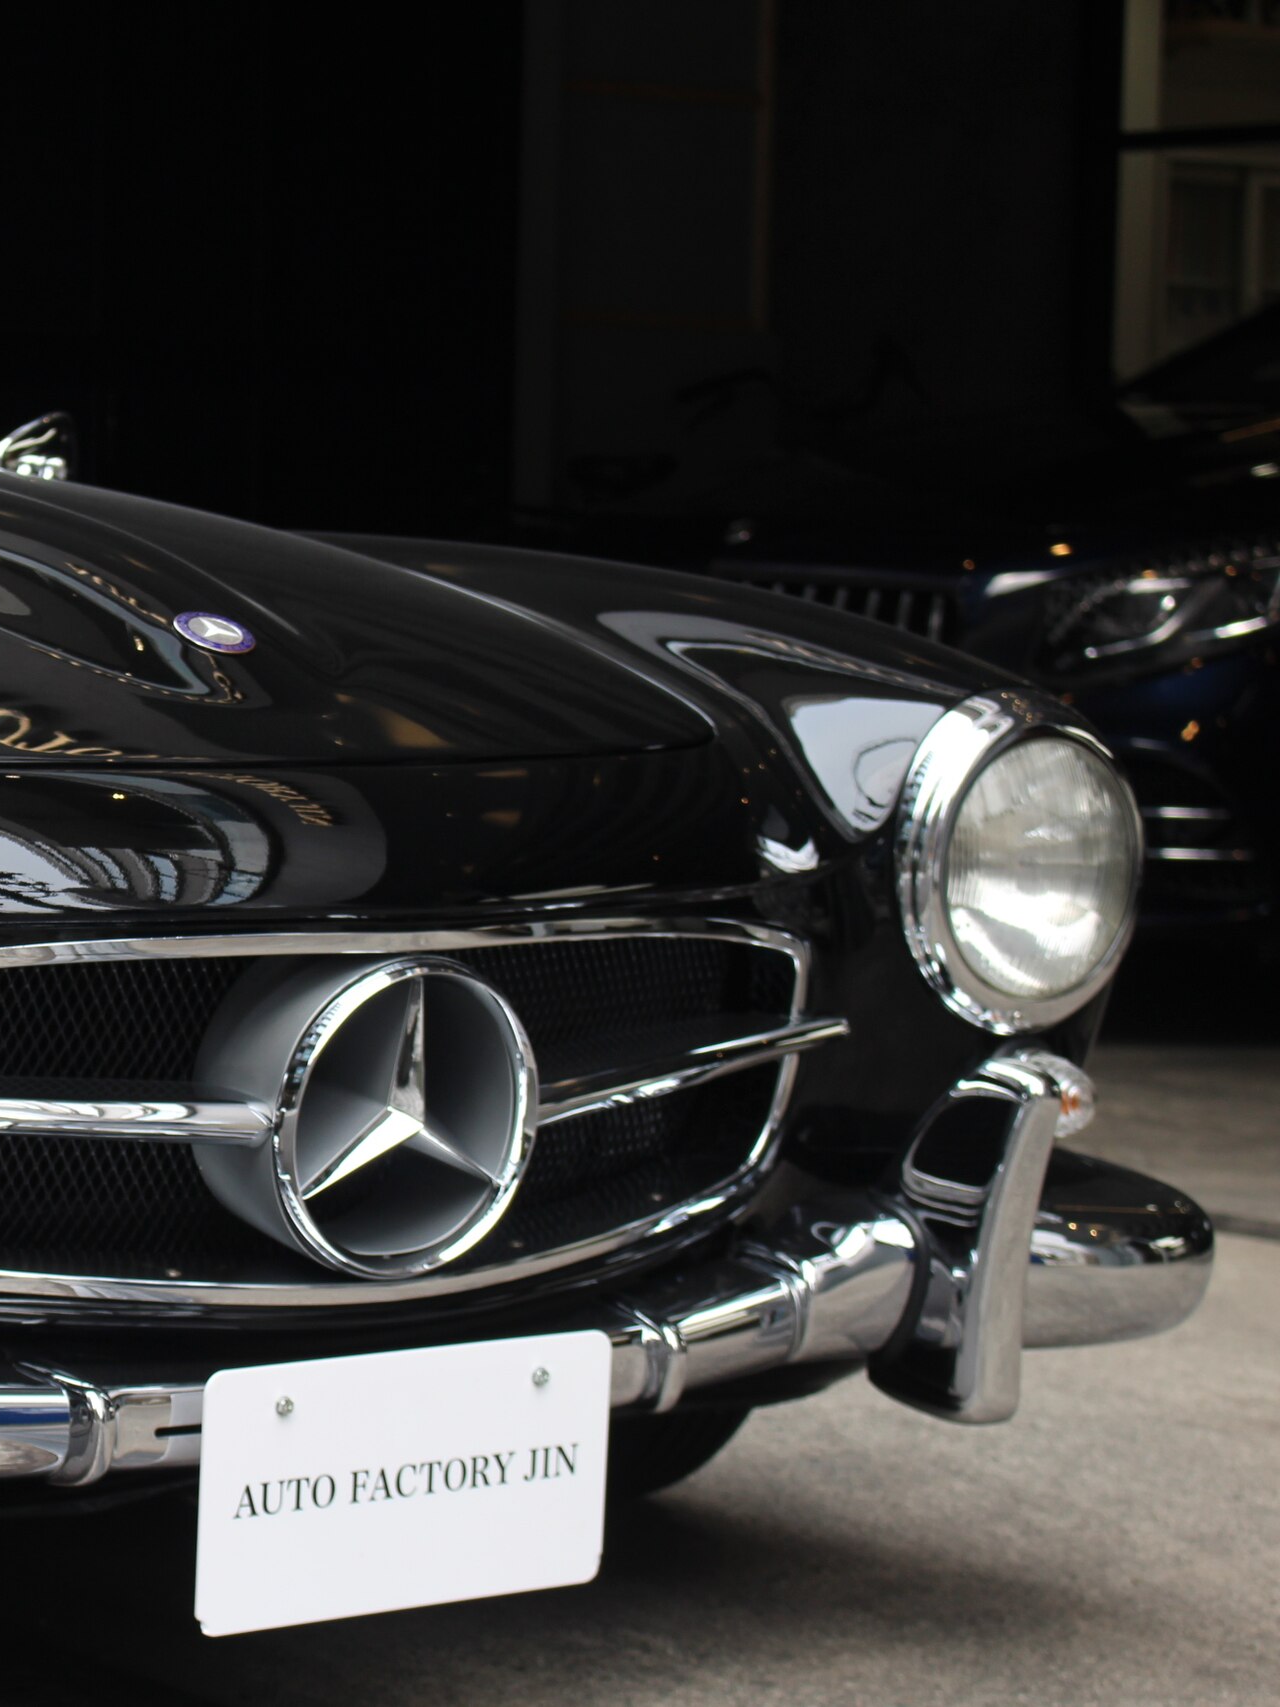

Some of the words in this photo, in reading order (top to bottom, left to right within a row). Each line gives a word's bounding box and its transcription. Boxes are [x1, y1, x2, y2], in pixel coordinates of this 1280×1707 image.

[233, 1474, 336, 1520] AUTO
[350, 1451, 515, 1505] FACTORY
[523, 1443, 579, 1482] JIN
